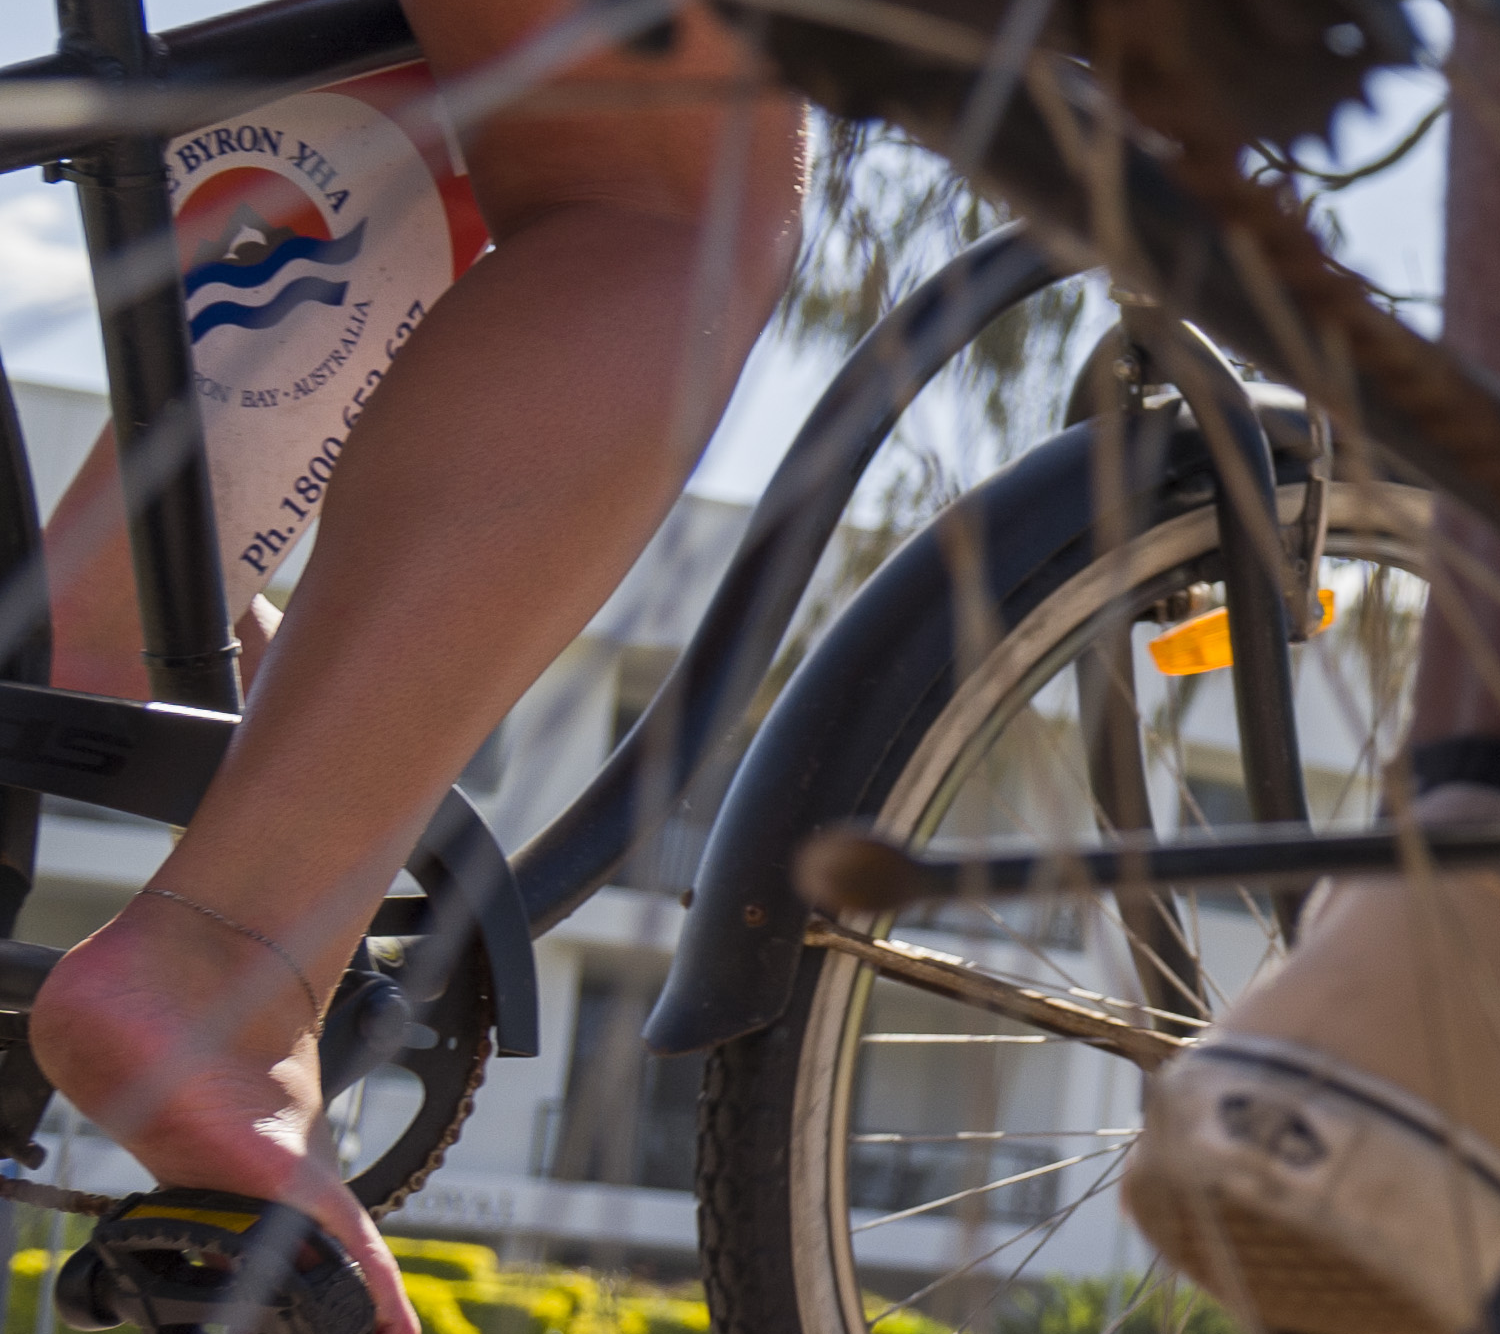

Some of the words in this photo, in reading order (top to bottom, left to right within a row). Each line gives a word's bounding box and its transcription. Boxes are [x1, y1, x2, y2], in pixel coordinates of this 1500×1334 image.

[176, 124, 284, 174] BYRON
[286, 140, 351, 214] YHA
[241, 389, 280, 408] BAY
[293, 300, 372, 400] AUSTRALIA
